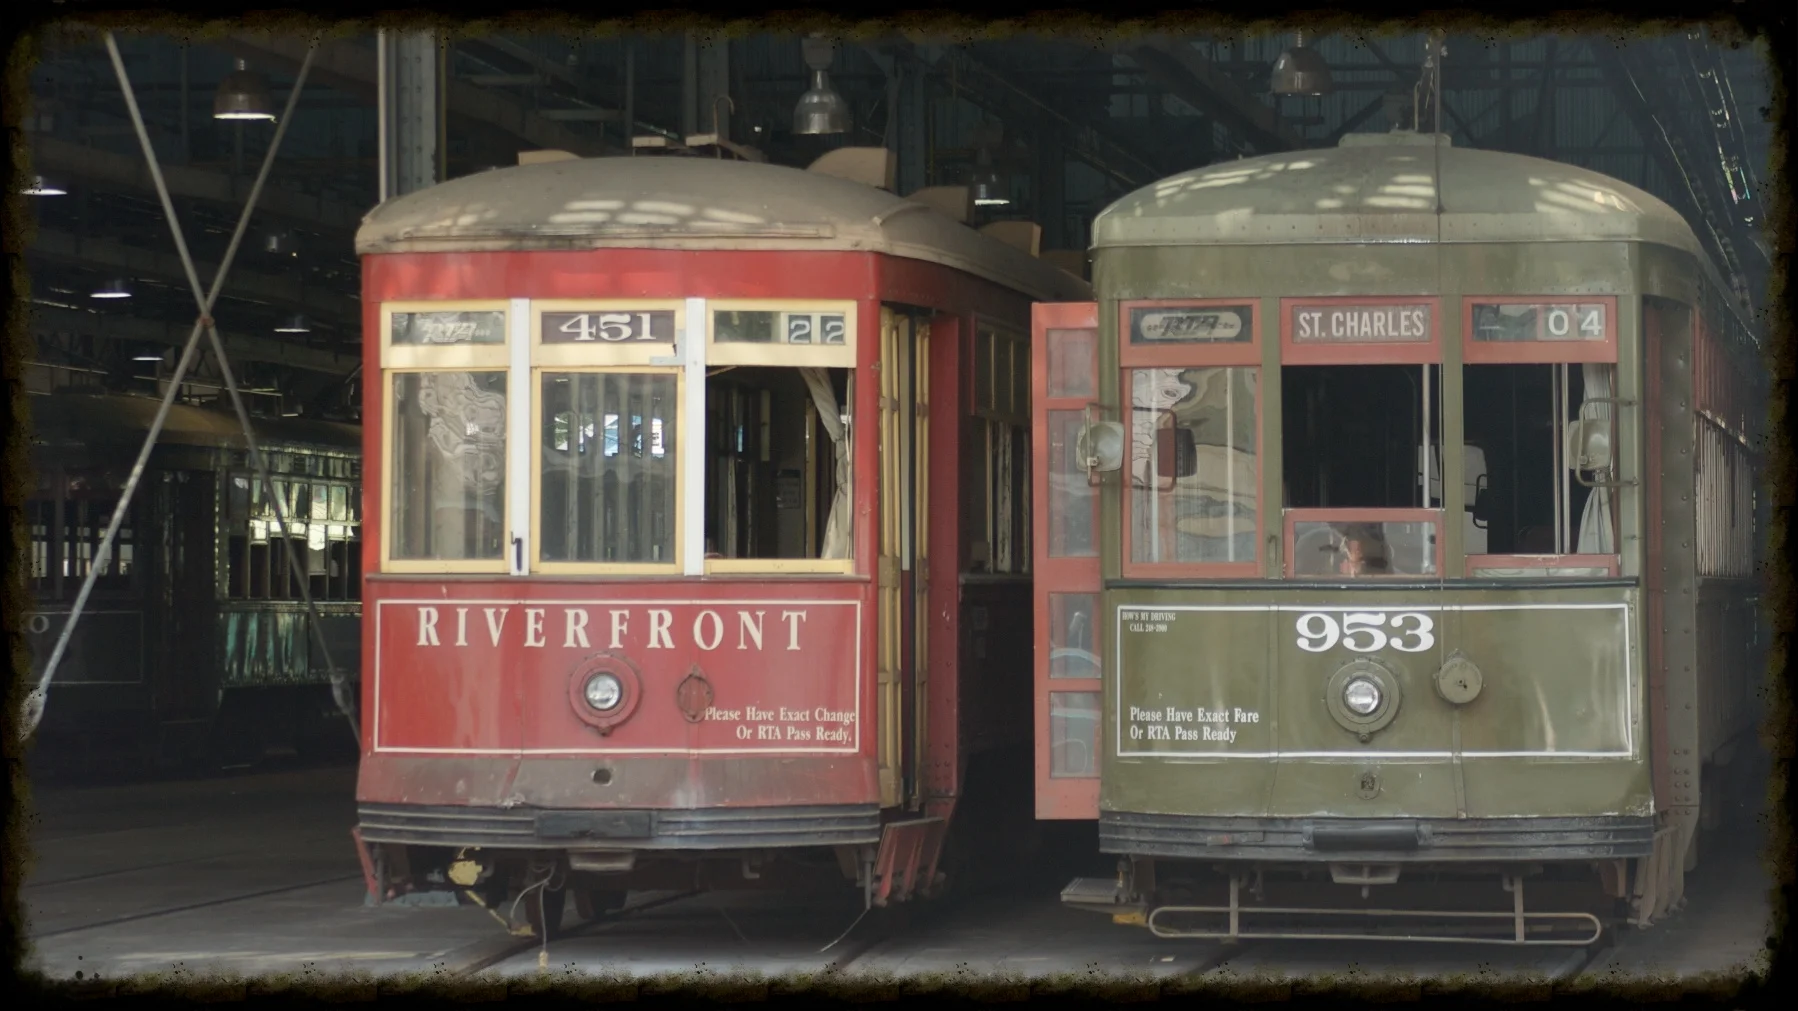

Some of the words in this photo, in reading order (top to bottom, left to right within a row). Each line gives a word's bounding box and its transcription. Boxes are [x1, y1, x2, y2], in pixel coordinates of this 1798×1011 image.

[559, 312, 657, 341] 451
[1298, 312, 1326, 338] ST.
[1331, 310, 1425, 337] CHARLES
[1140, 611, 1149, 621] MY
[1150, 612, 1176, 622] DRIVING
[416, 606, 807, 651] RIVERFRONT
[1129, 623, 1144, 632] CALL
[1295, 612, 1435, 652] 953
[705, 706, 741, 721] Please
[746, 706, 775, 721] Have
[780, 707, 810, 721] Exact
[815, 707, 855, 725] Change
[1130, 706, 1162, 722] Please
[1166, 707, 1193, 722] Have
[1197, 707, 1230, 722] Exact
[1234, 708, 1260, 723] Fare
[736, 725, 753, 740] Or
[758, 725, 782, 740] RTA
[787, 726, 811, 741] Pass
[816, 726, 852, 745] Ready.
[1130, 725, 1144, 740] Or
[1147, 725, 1171, 740] RTA
[1175, 726, 1198, 741] Pass
[1203, 726, 1237, 744] Ready
